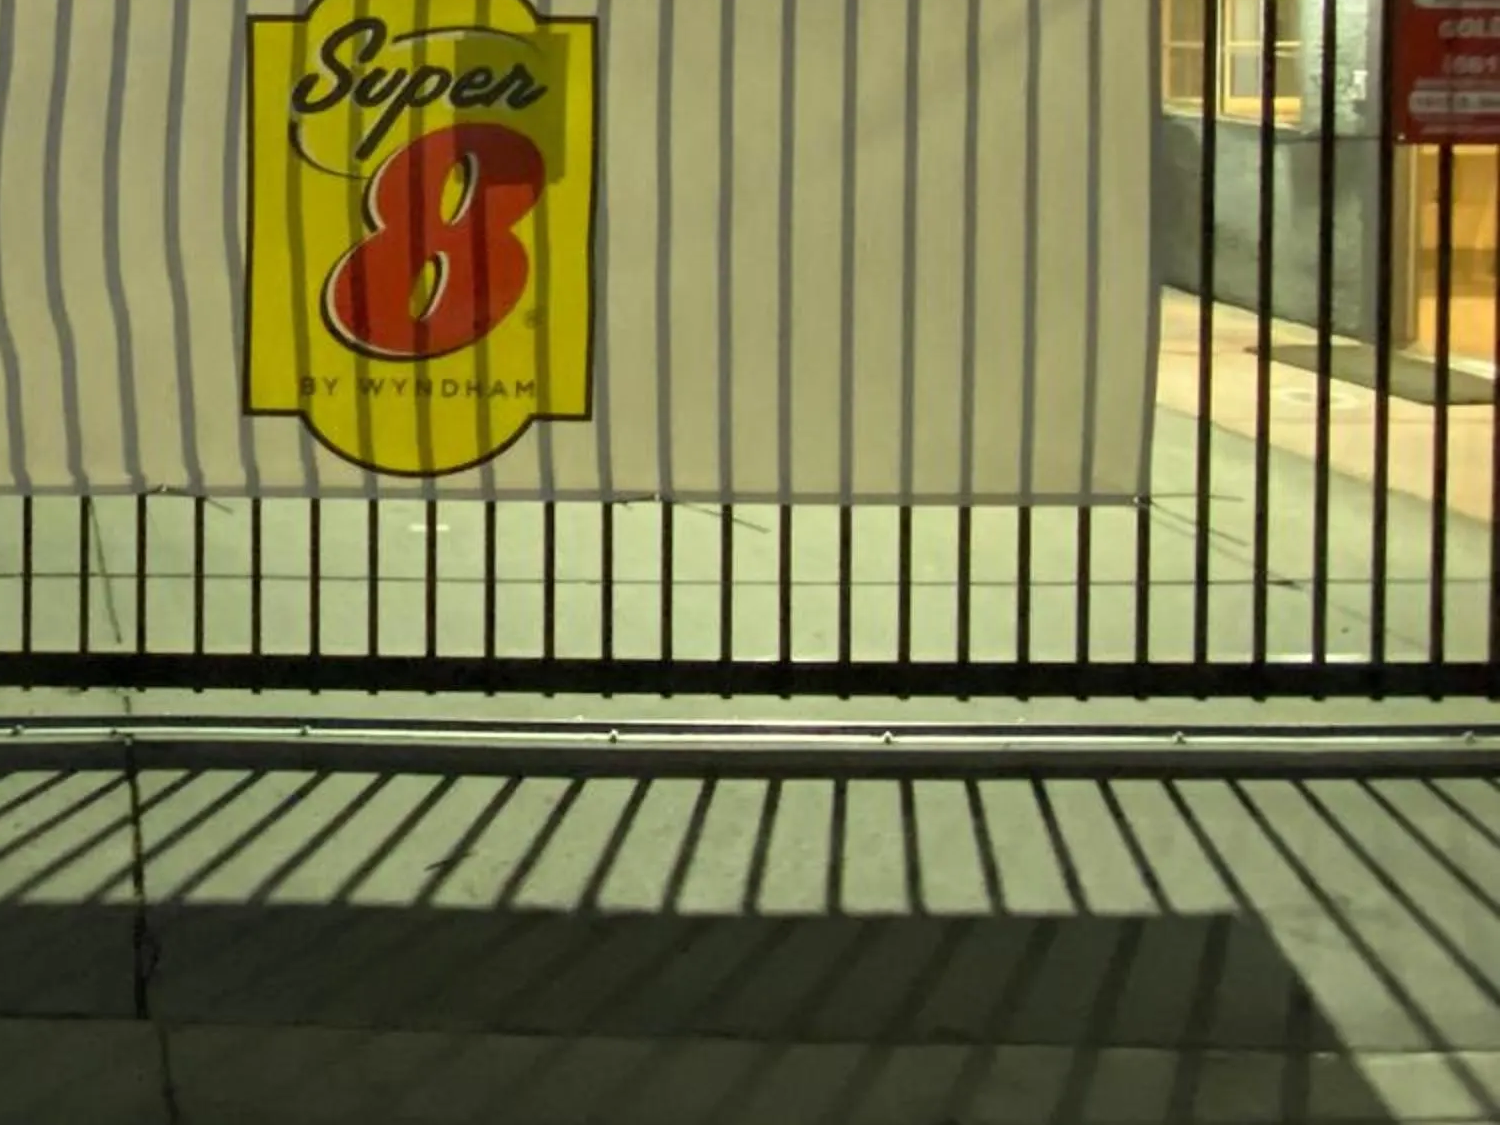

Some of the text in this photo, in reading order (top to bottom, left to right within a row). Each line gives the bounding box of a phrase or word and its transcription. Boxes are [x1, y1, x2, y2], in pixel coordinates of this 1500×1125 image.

[290, 17, 548, 161] Super
[320, 122, 546, 363] 8
[299, 377, 536, 398] BY WYNDHAM
